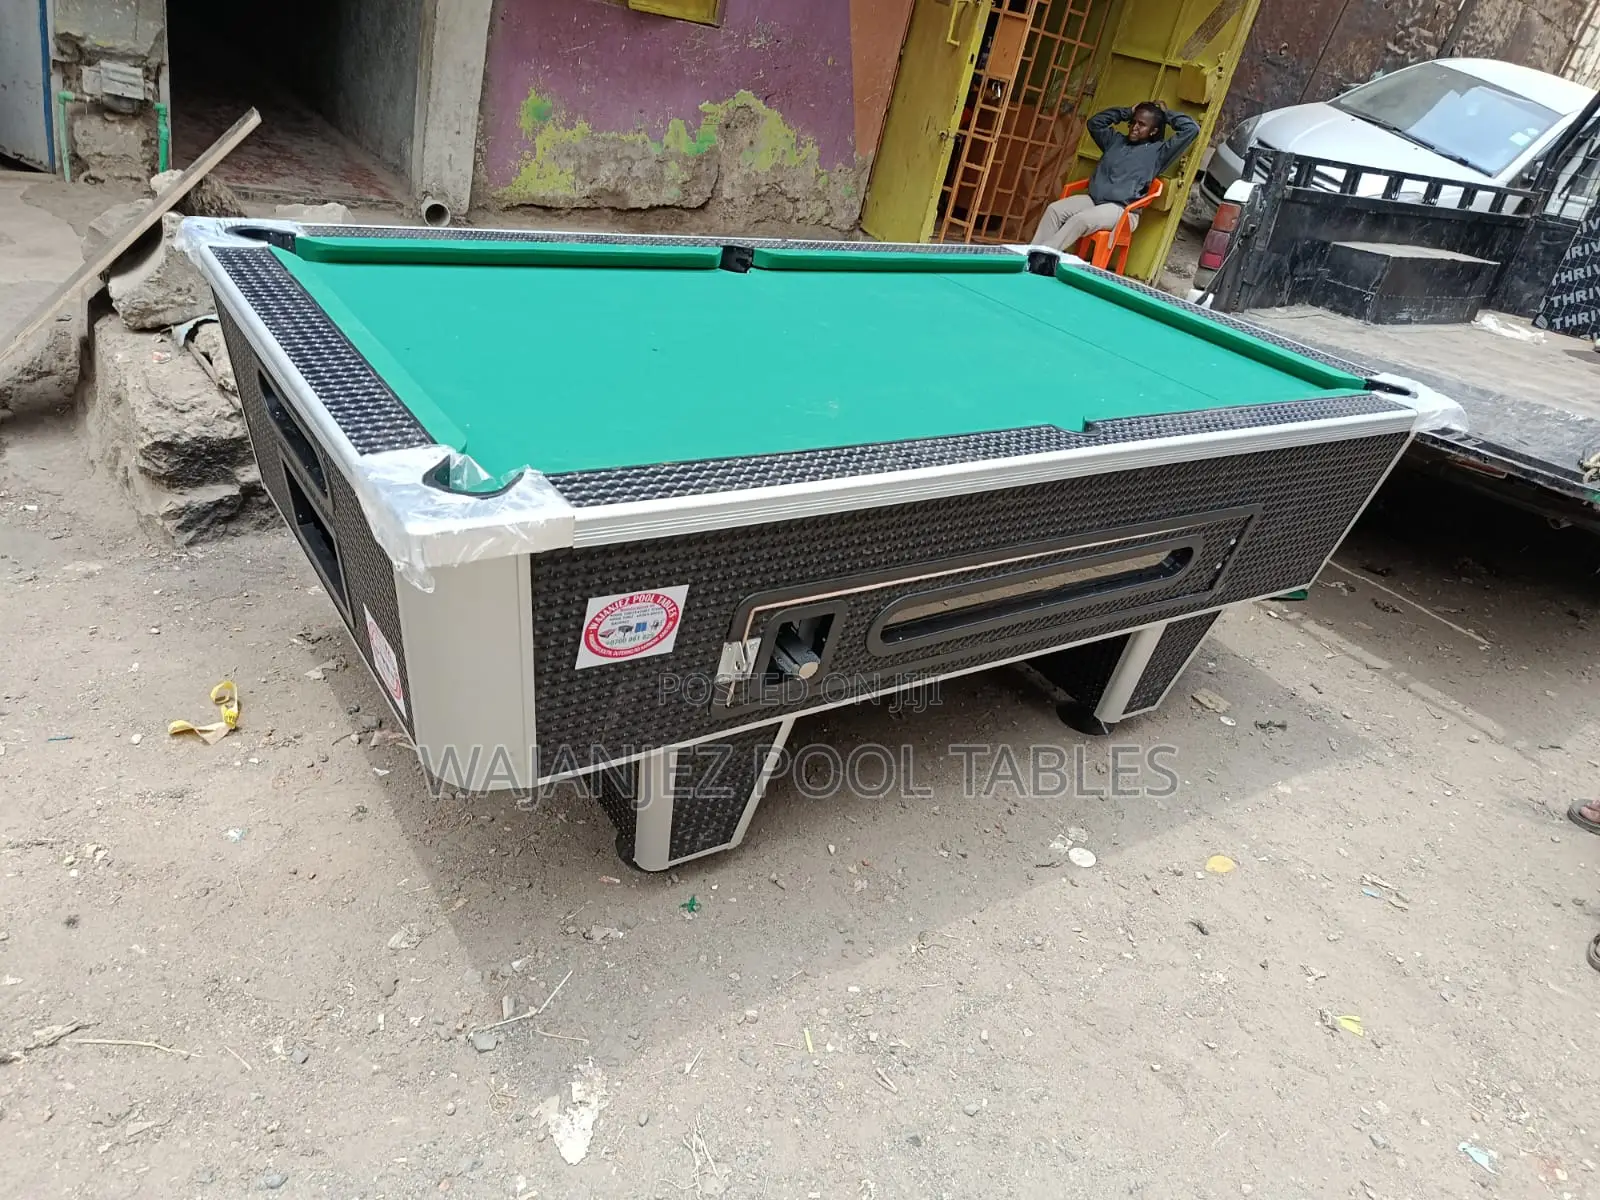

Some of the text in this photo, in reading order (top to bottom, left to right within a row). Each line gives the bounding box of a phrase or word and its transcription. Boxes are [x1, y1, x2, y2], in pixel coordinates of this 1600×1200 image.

[1576, 217, 1600, 234] IV
[1552, 308, 1600, 330] THRI
[633, 593, 655, 604] POOL
[657, 596, 677, 618] TABLES
